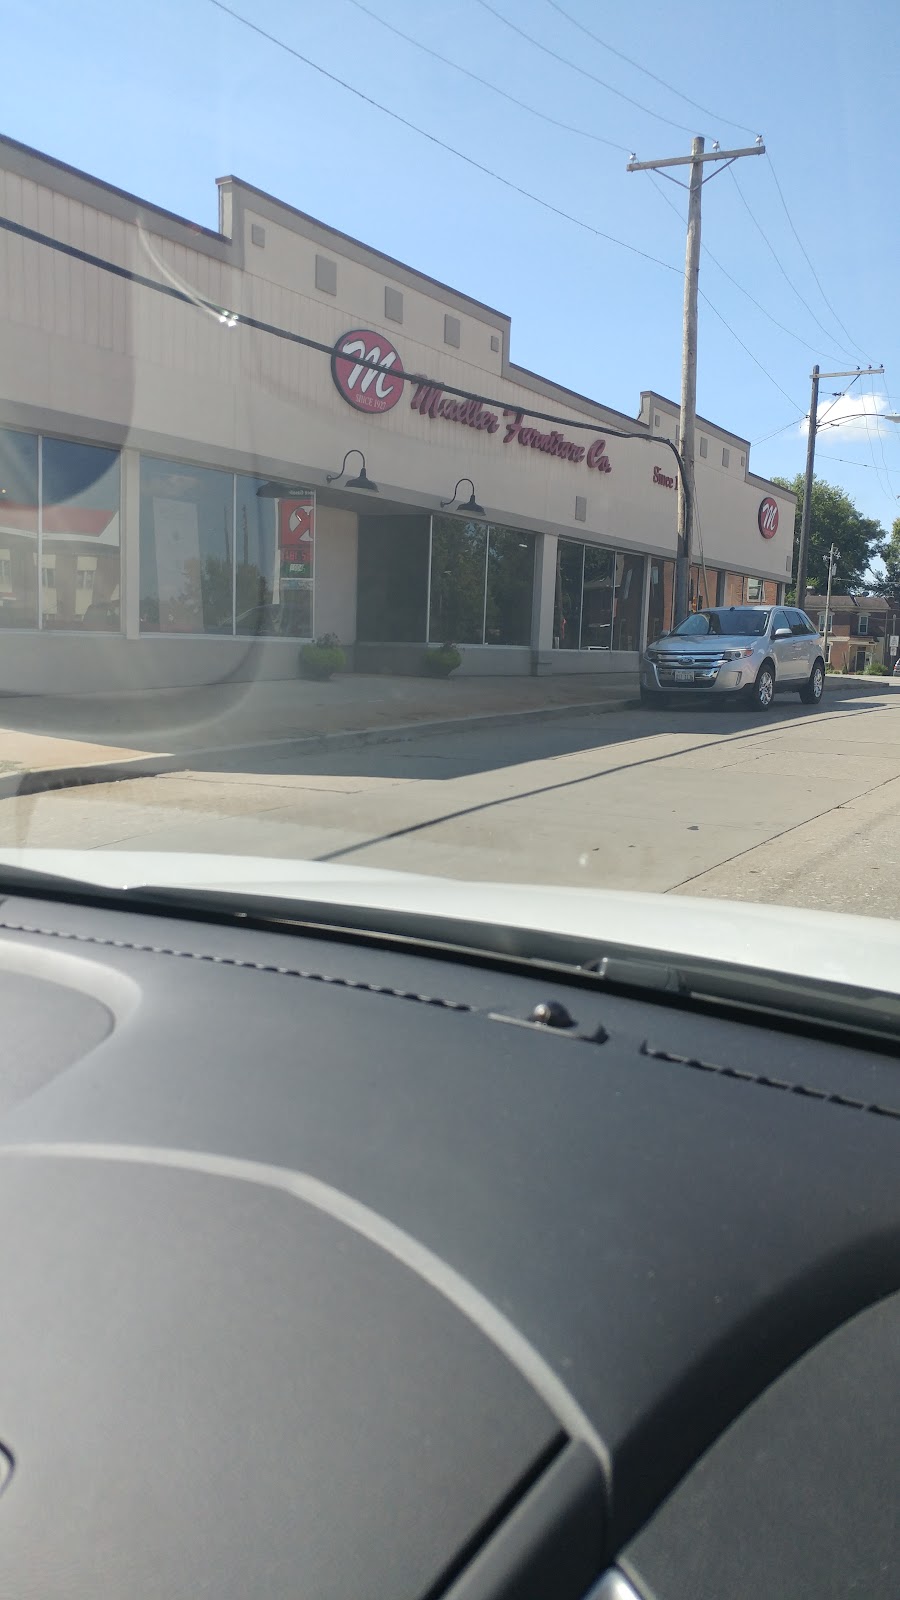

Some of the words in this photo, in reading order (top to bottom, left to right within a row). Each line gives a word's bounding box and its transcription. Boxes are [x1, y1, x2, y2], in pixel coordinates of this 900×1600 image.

[355, 393, 374, 407] SINCE
[410, 374, 500, 434] Mueller
[502, 405, 586, 463] Furniture
[652, 465, 674, 489] Since
